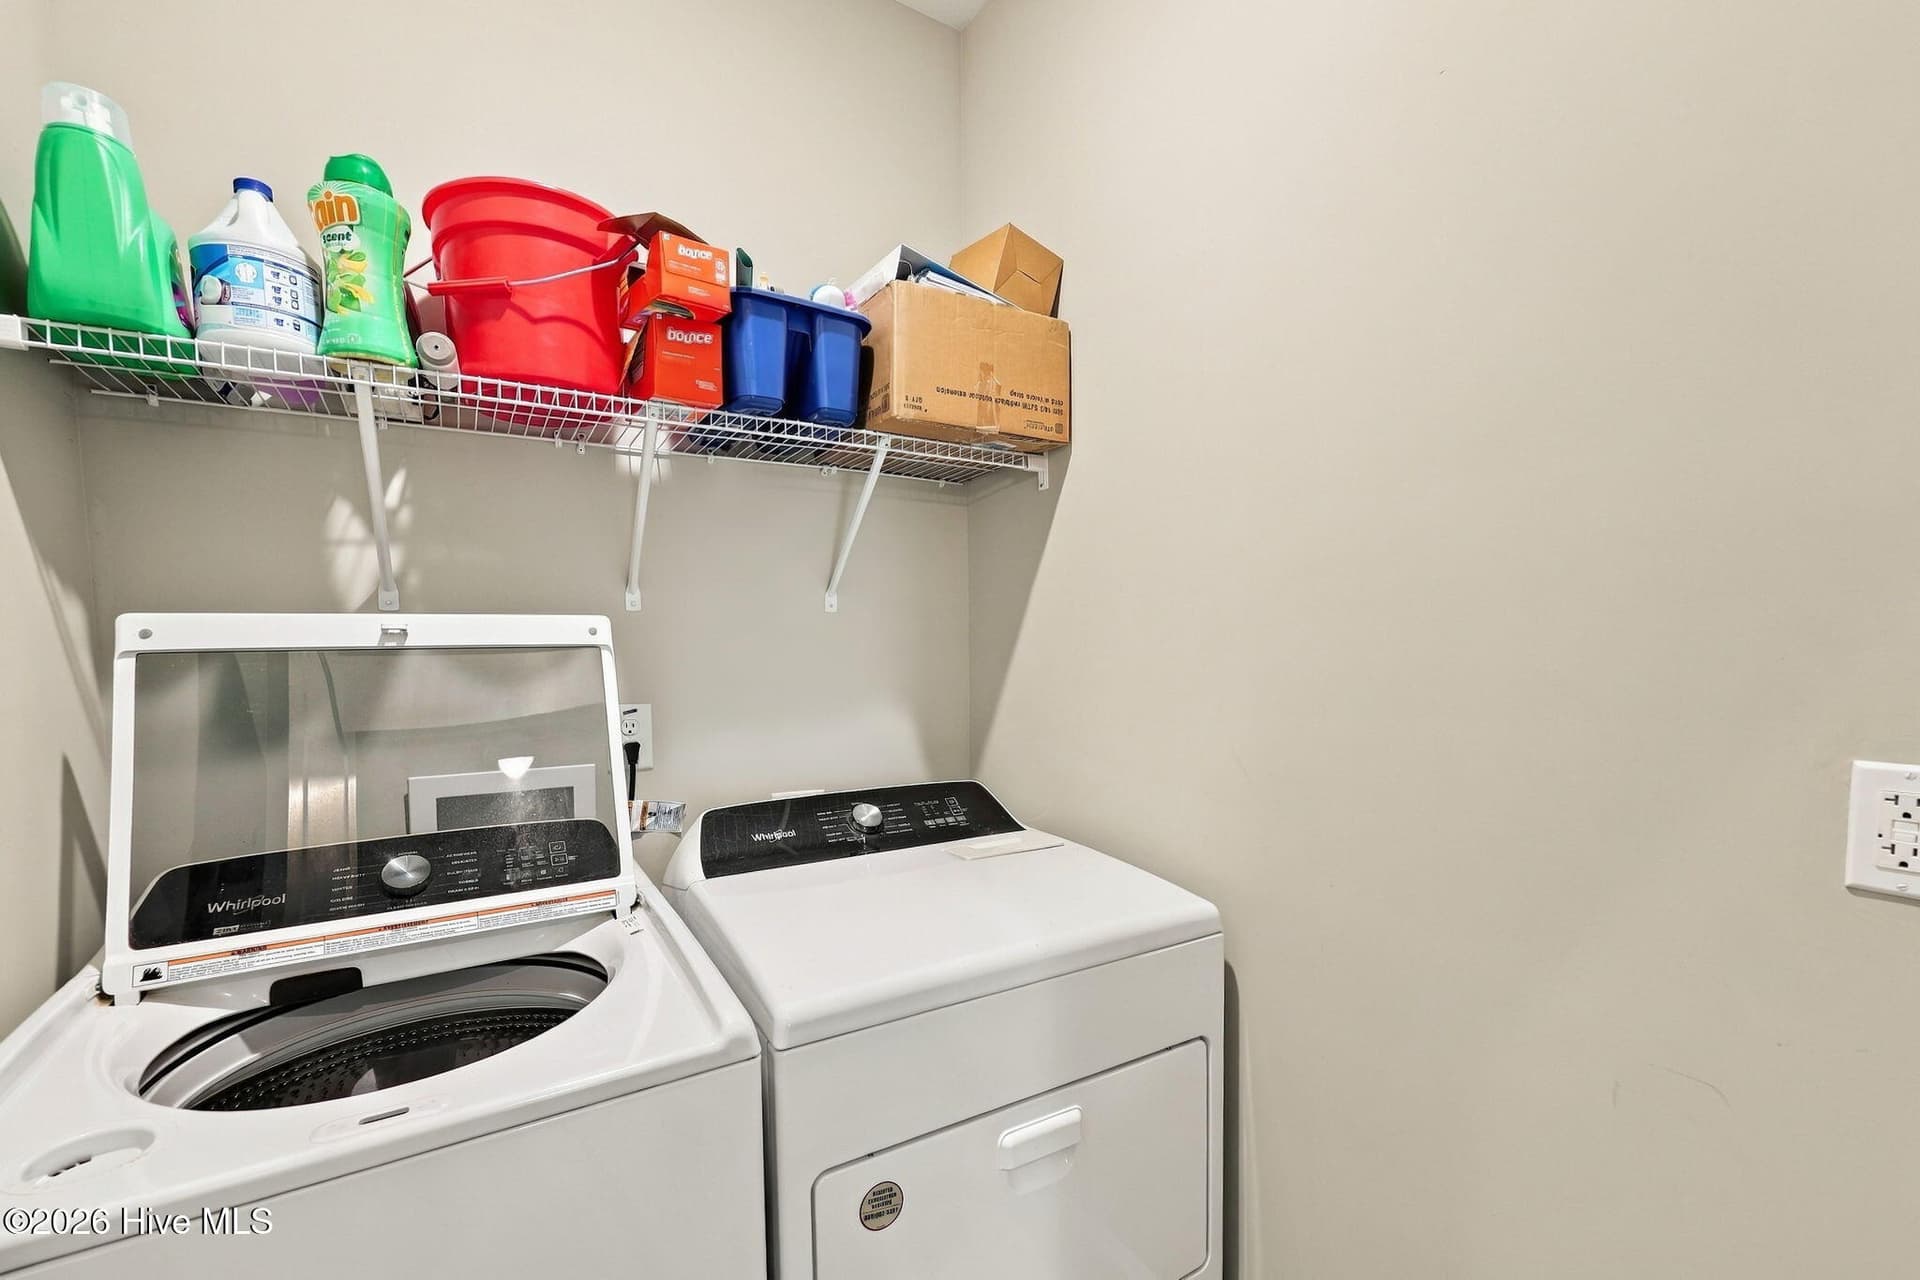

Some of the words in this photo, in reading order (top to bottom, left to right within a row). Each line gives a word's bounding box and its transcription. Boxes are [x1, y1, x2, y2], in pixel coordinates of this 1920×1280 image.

[666, 326, 713, 345] bounce
[750, 828, 797, 843] Whirlpool
[207, 893, 287, 915] Whirlpool
